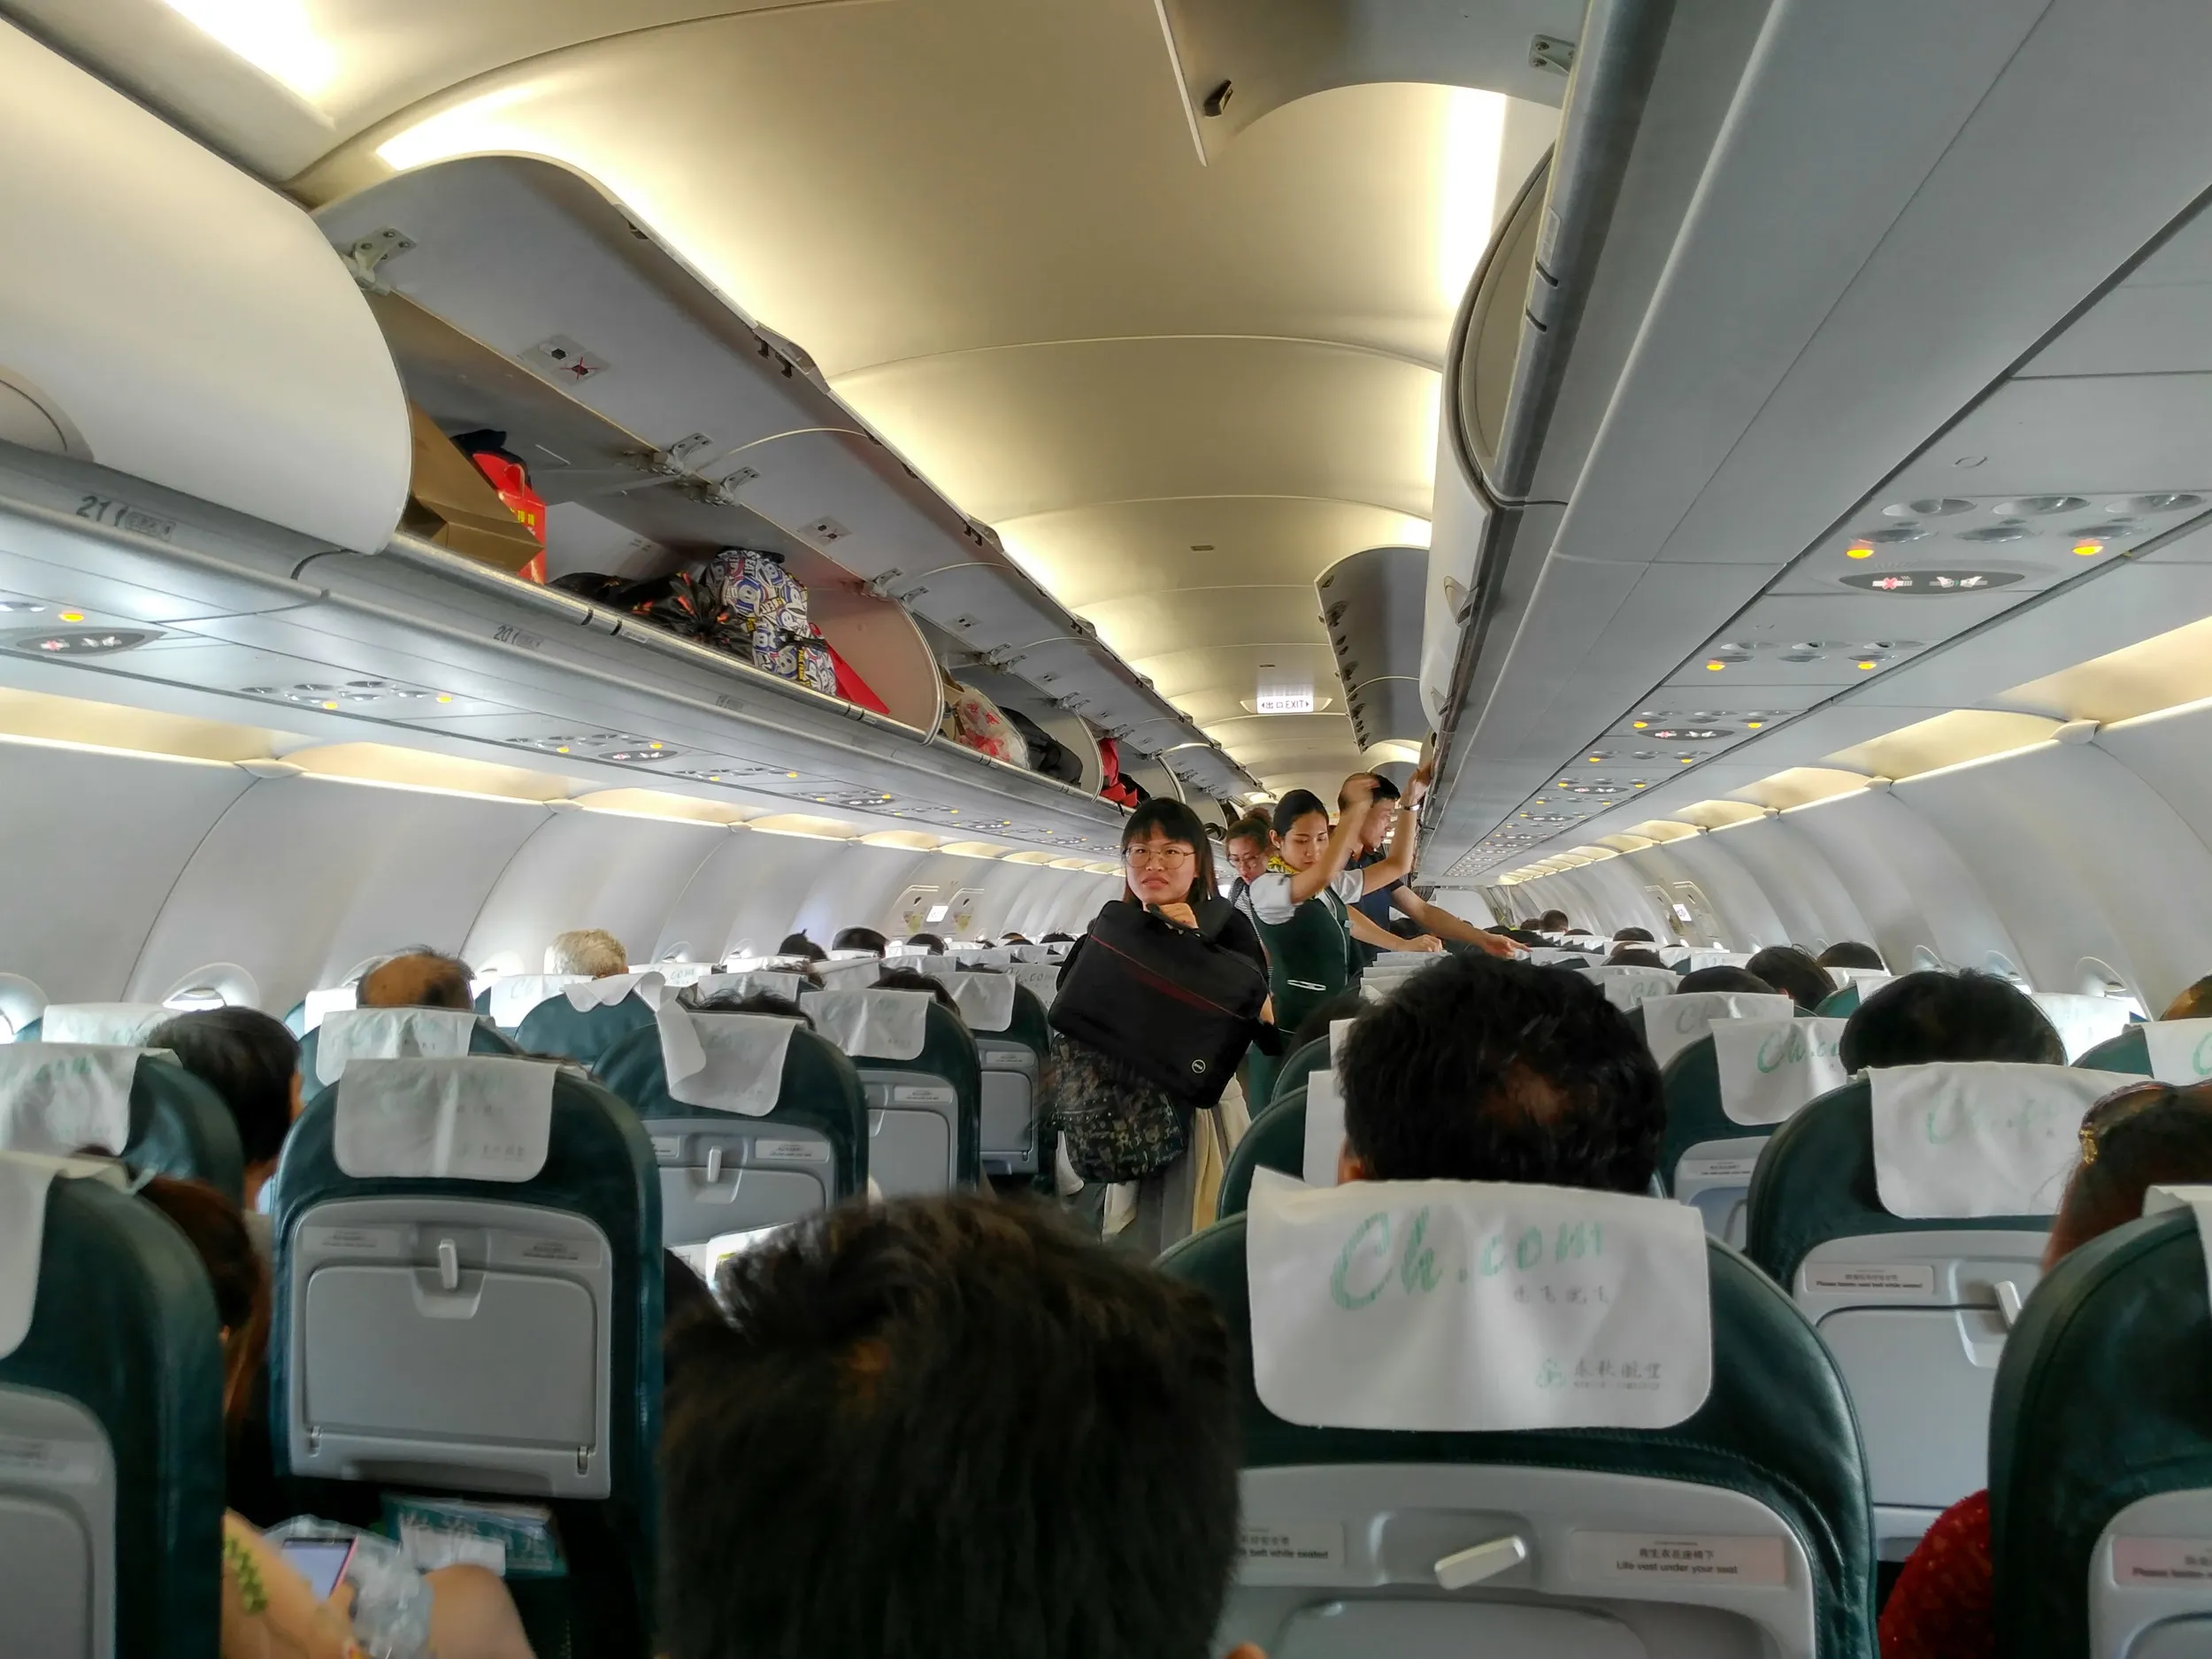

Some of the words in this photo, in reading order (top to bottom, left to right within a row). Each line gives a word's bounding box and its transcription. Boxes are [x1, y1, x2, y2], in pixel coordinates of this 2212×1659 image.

[1286, 700, 1304, 709] EXIT
[1330, 1204, 1603, 1310] Ch.com
[1616, 1561, 1634, 1571] Life
[1660, 1563, 1688, 1573] under
[1691, 1565, 1713, 1575] your
